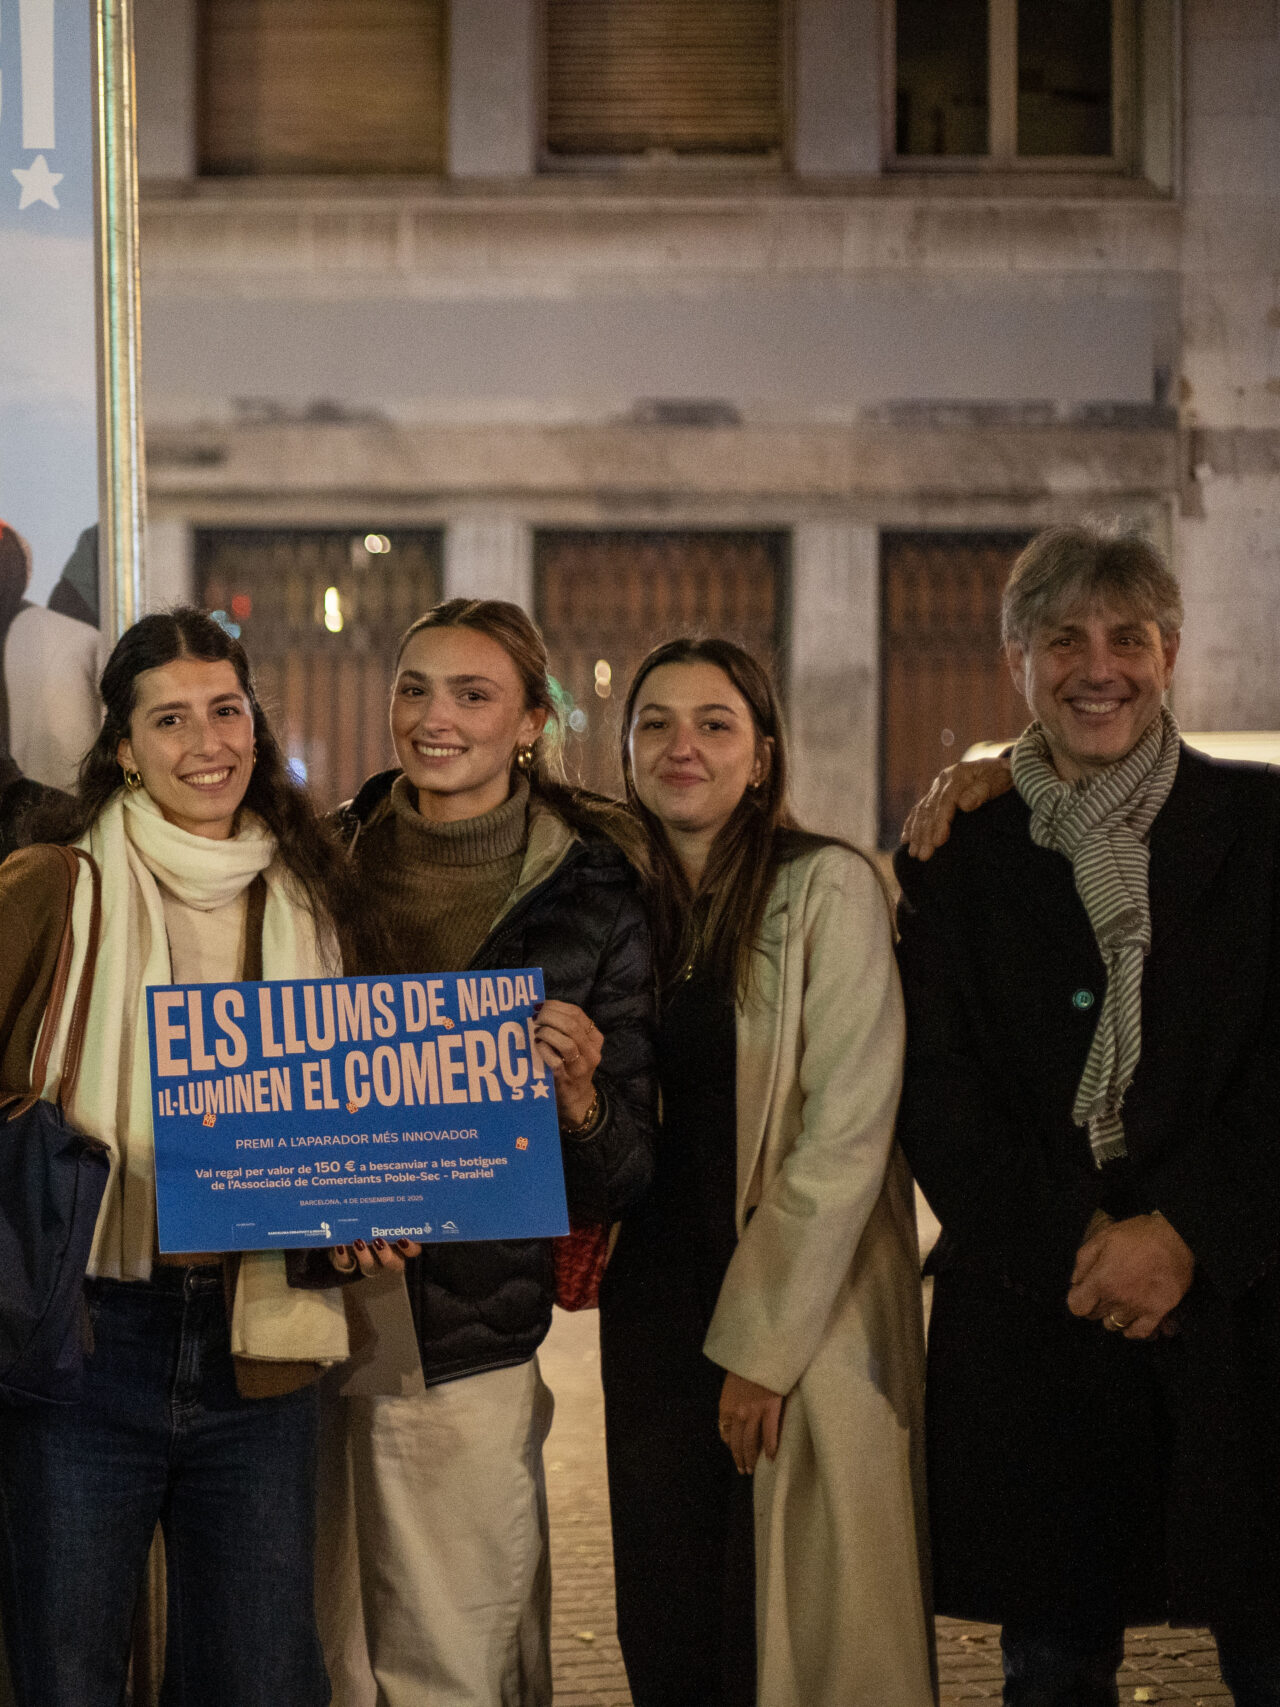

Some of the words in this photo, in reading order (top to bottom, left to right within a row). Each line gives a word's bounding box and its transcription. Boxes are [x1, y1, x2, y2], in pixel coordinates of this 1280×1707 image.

[153, 988, 248, 1077] ELS
[258, 981, 397, 1058] LLUMS
[402, 979, 447, 1033] DE
[456, 975, 538, 1022] NADAL
[302, 1058, 340, 1111] EL
[235, 1137, 274, 1150] PREMI
[277, 1137, 288, 1148] A
[290, 1133, 369, 1148] L'APARADOR
[372, 1130, 399, 1144] MÉS
[402, 1128, 478, 1143] INNOVADOR
[195, 1168, 213, 1179] Val
[215, 1167, 242, 1180] regal
[245, 1168, 265, 1179] per
[267, 1165, 294, 1176] valor
[297, 1164, 312, 1175] de
[314, 1160, 341, 1173] 150
[344, 1160, 356, 1172] €
[359, 1163, 367, 1171] a
[369, 1160, 429, 1171] bescanviar
[431, 1160, 439, 1168] a
[441, 1157, 457, 1168] les
[459, 1156, 508, 1168] botigues
[210, 1179, 226, 1190] de
[228, 1177, 292, 1190] l'Associació
[294, 1176, 309, 1187] de
[311, 1173, 382, 1187] Comerciants
[384, 1171, 441, 1183] Poble-Sec
[371, 1226, 424, 1237] Barcelona
